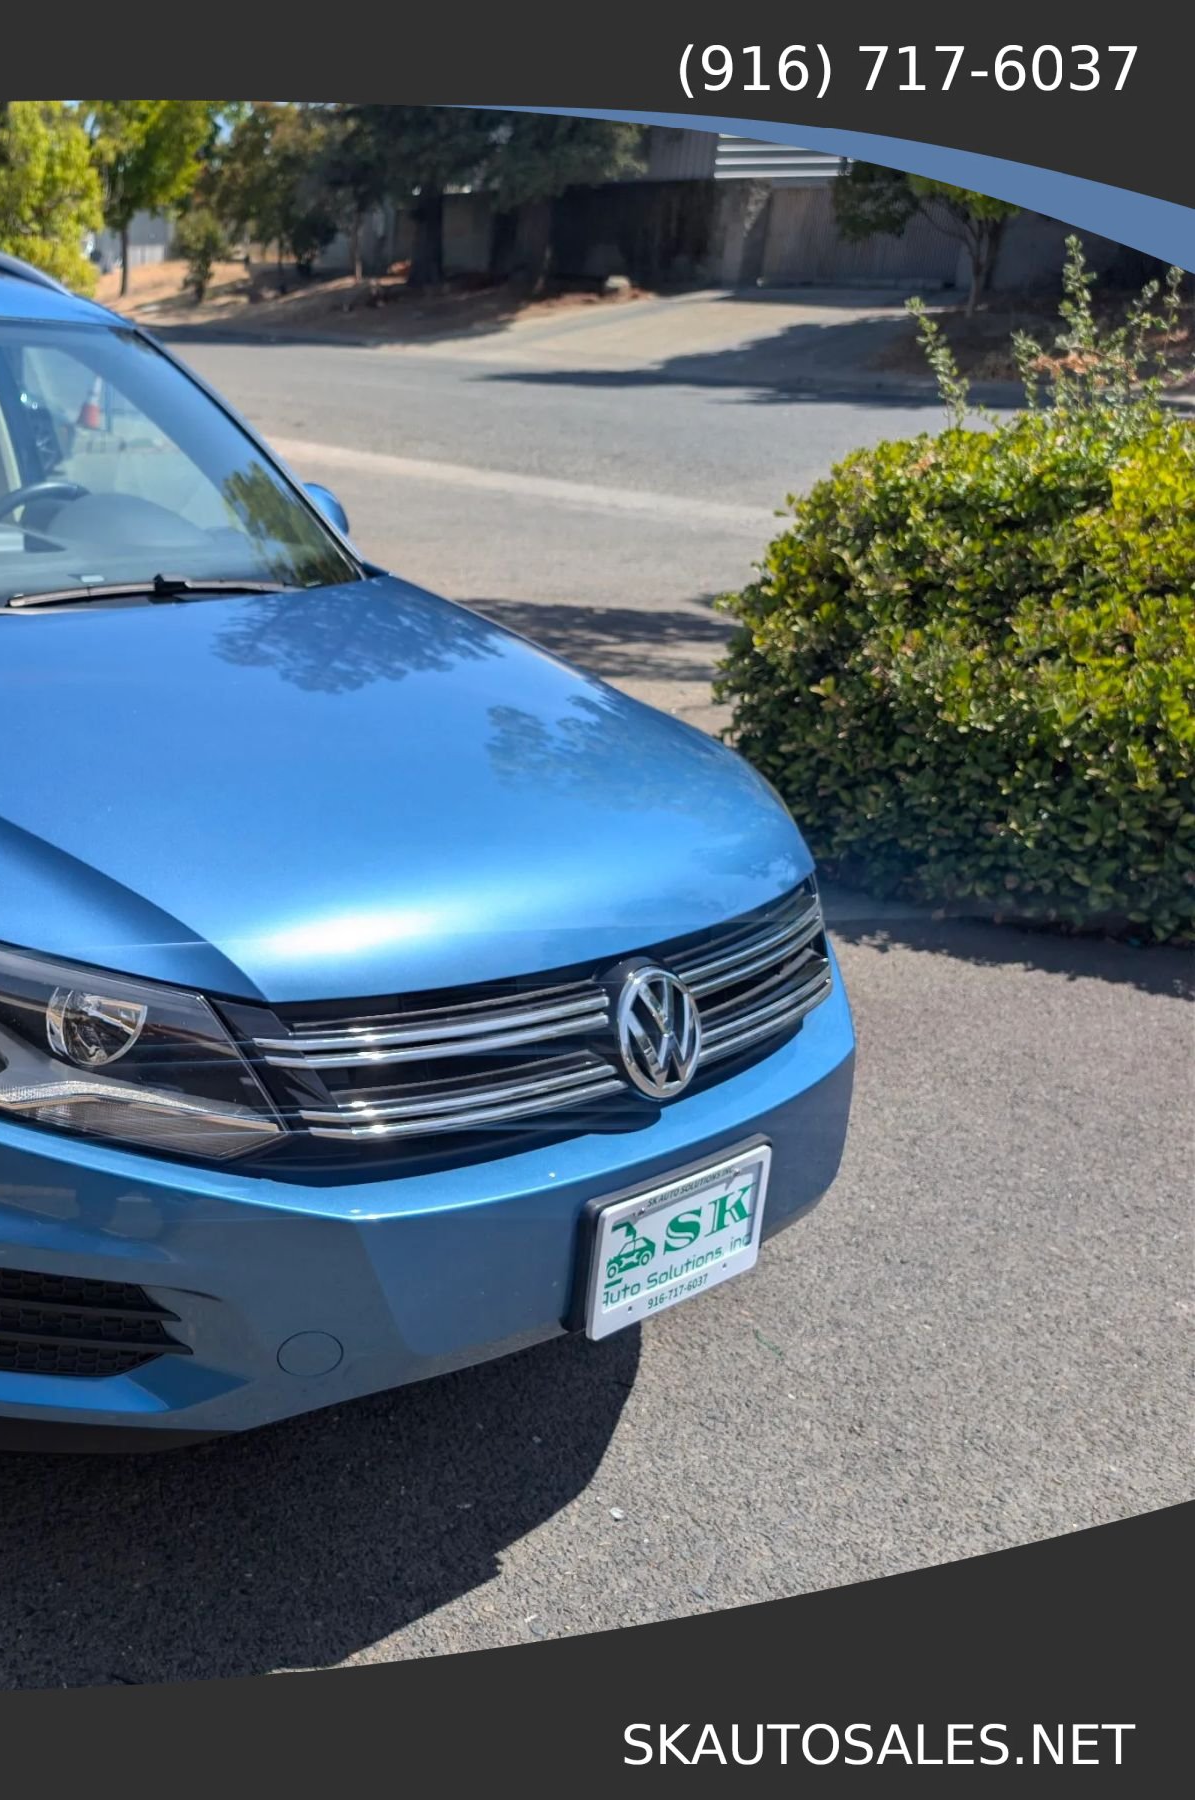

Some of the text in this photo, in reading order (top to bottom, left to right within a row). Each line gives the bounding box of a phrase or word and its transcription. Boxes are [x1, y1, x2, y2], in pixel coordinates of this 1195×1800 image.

[659, 1188, 679, 1202] AUTO
[680, 1172, 721, 1193] SOLUTIONS
[662, 1182, 756, 1255] SK
[647, 1273, 709, 1309] 916-717-6037
